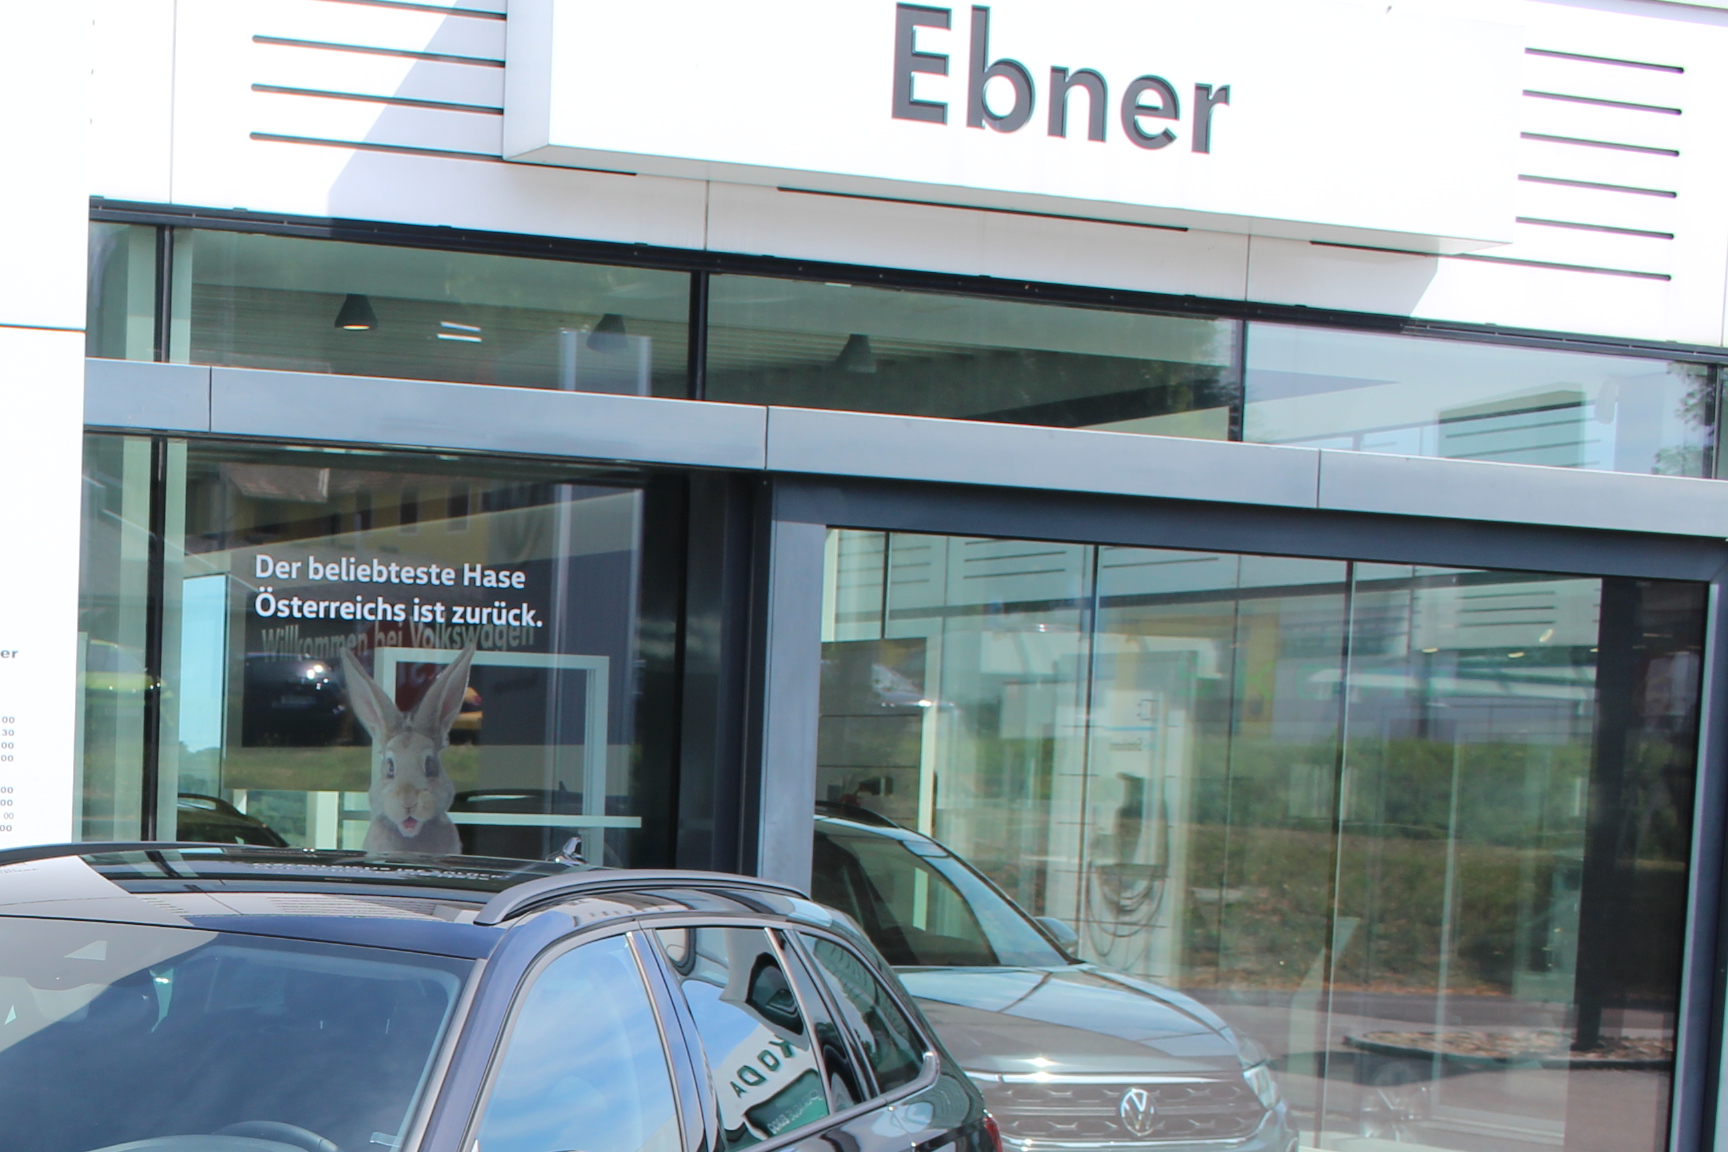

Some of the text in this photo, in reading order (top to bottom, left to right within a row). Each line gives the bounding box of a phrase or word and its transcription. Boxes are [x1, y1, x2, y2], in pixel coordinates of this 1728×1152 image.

[891, 2, 1231, 155] Ebner
[255, 554, 526, 589] Der beliebteste Hase
[255, 586, 543, 628] Österreichs ist zurück.
